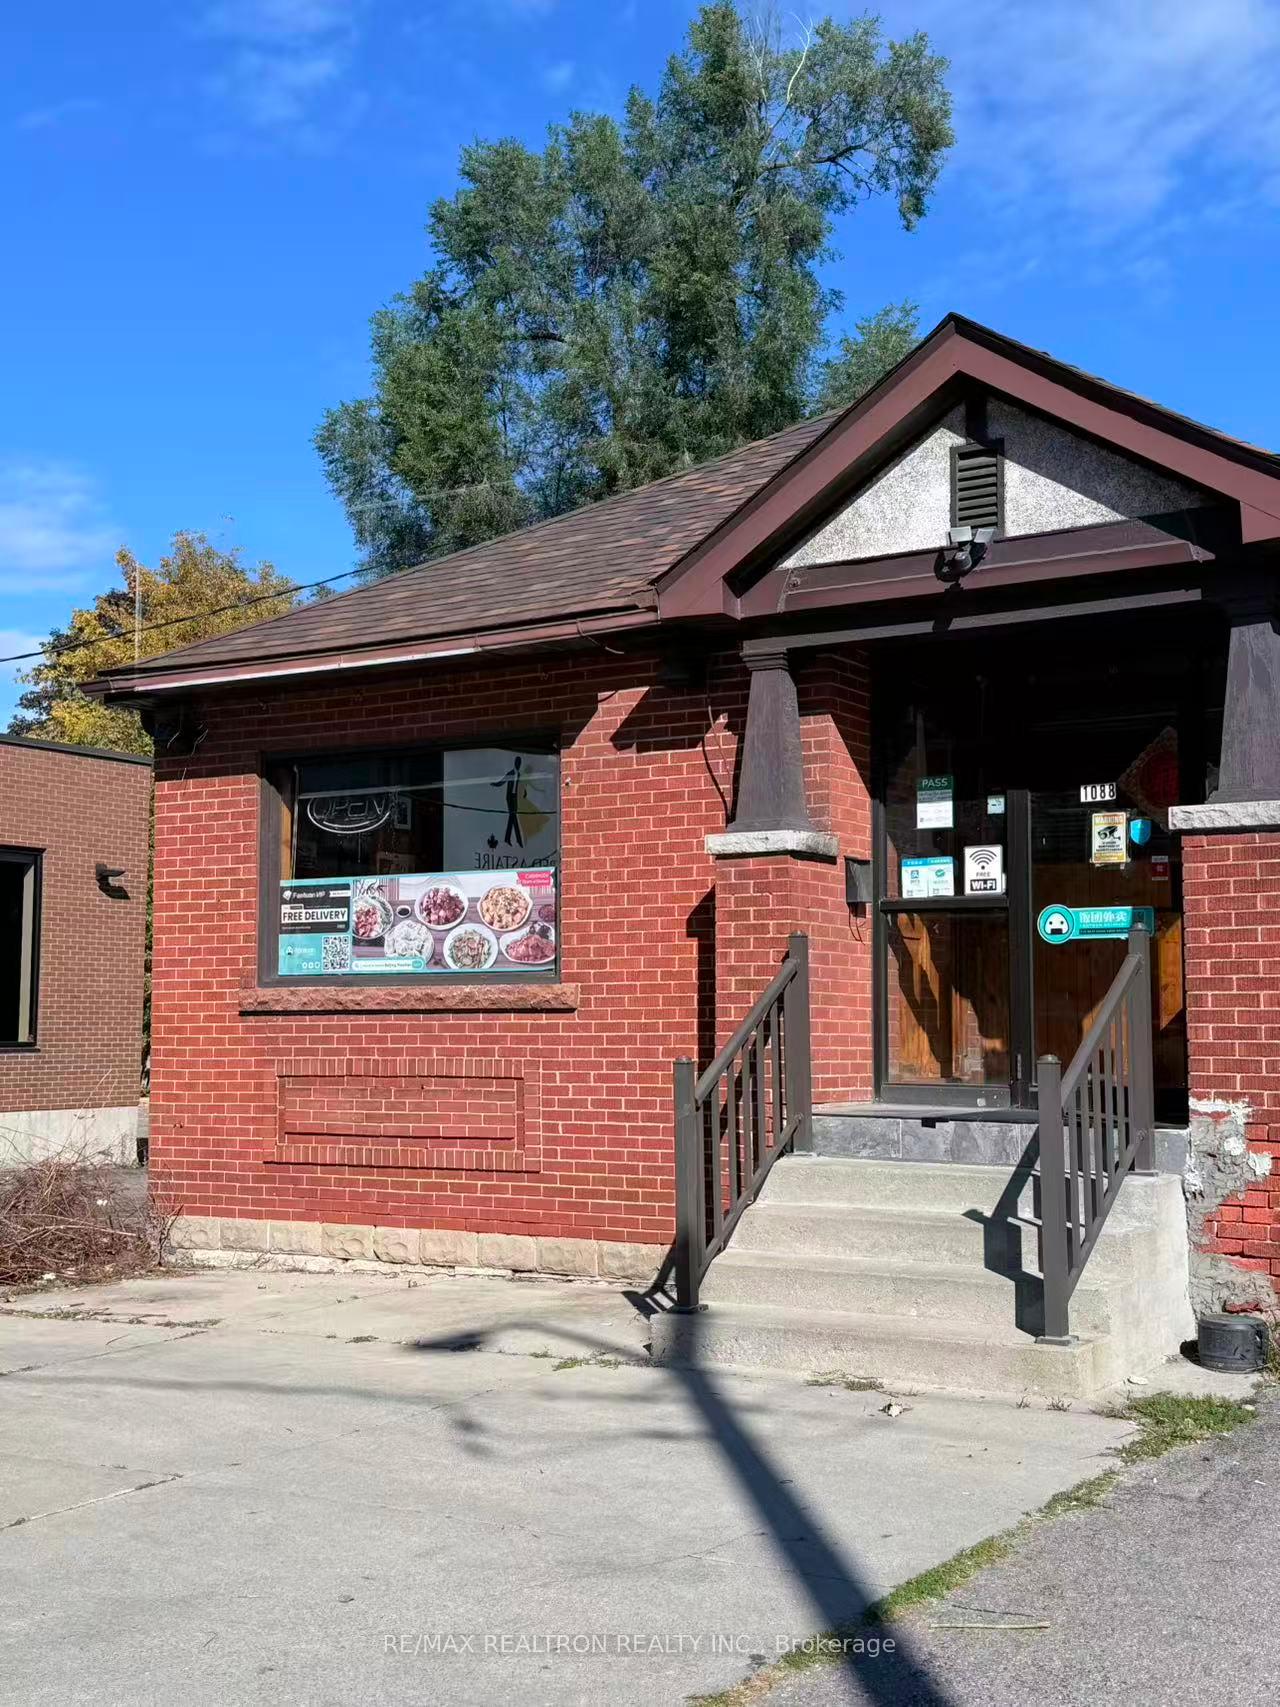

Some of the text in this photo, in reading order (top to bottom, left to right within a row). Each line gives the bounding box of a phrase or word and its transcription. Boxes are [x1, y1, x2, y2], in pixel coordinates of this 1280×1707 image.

[922, 778, 948, 788] PASS
[1083, 783, 1115, 800] 1088
[282, 910, 347, 922] FREE DELIVERY
